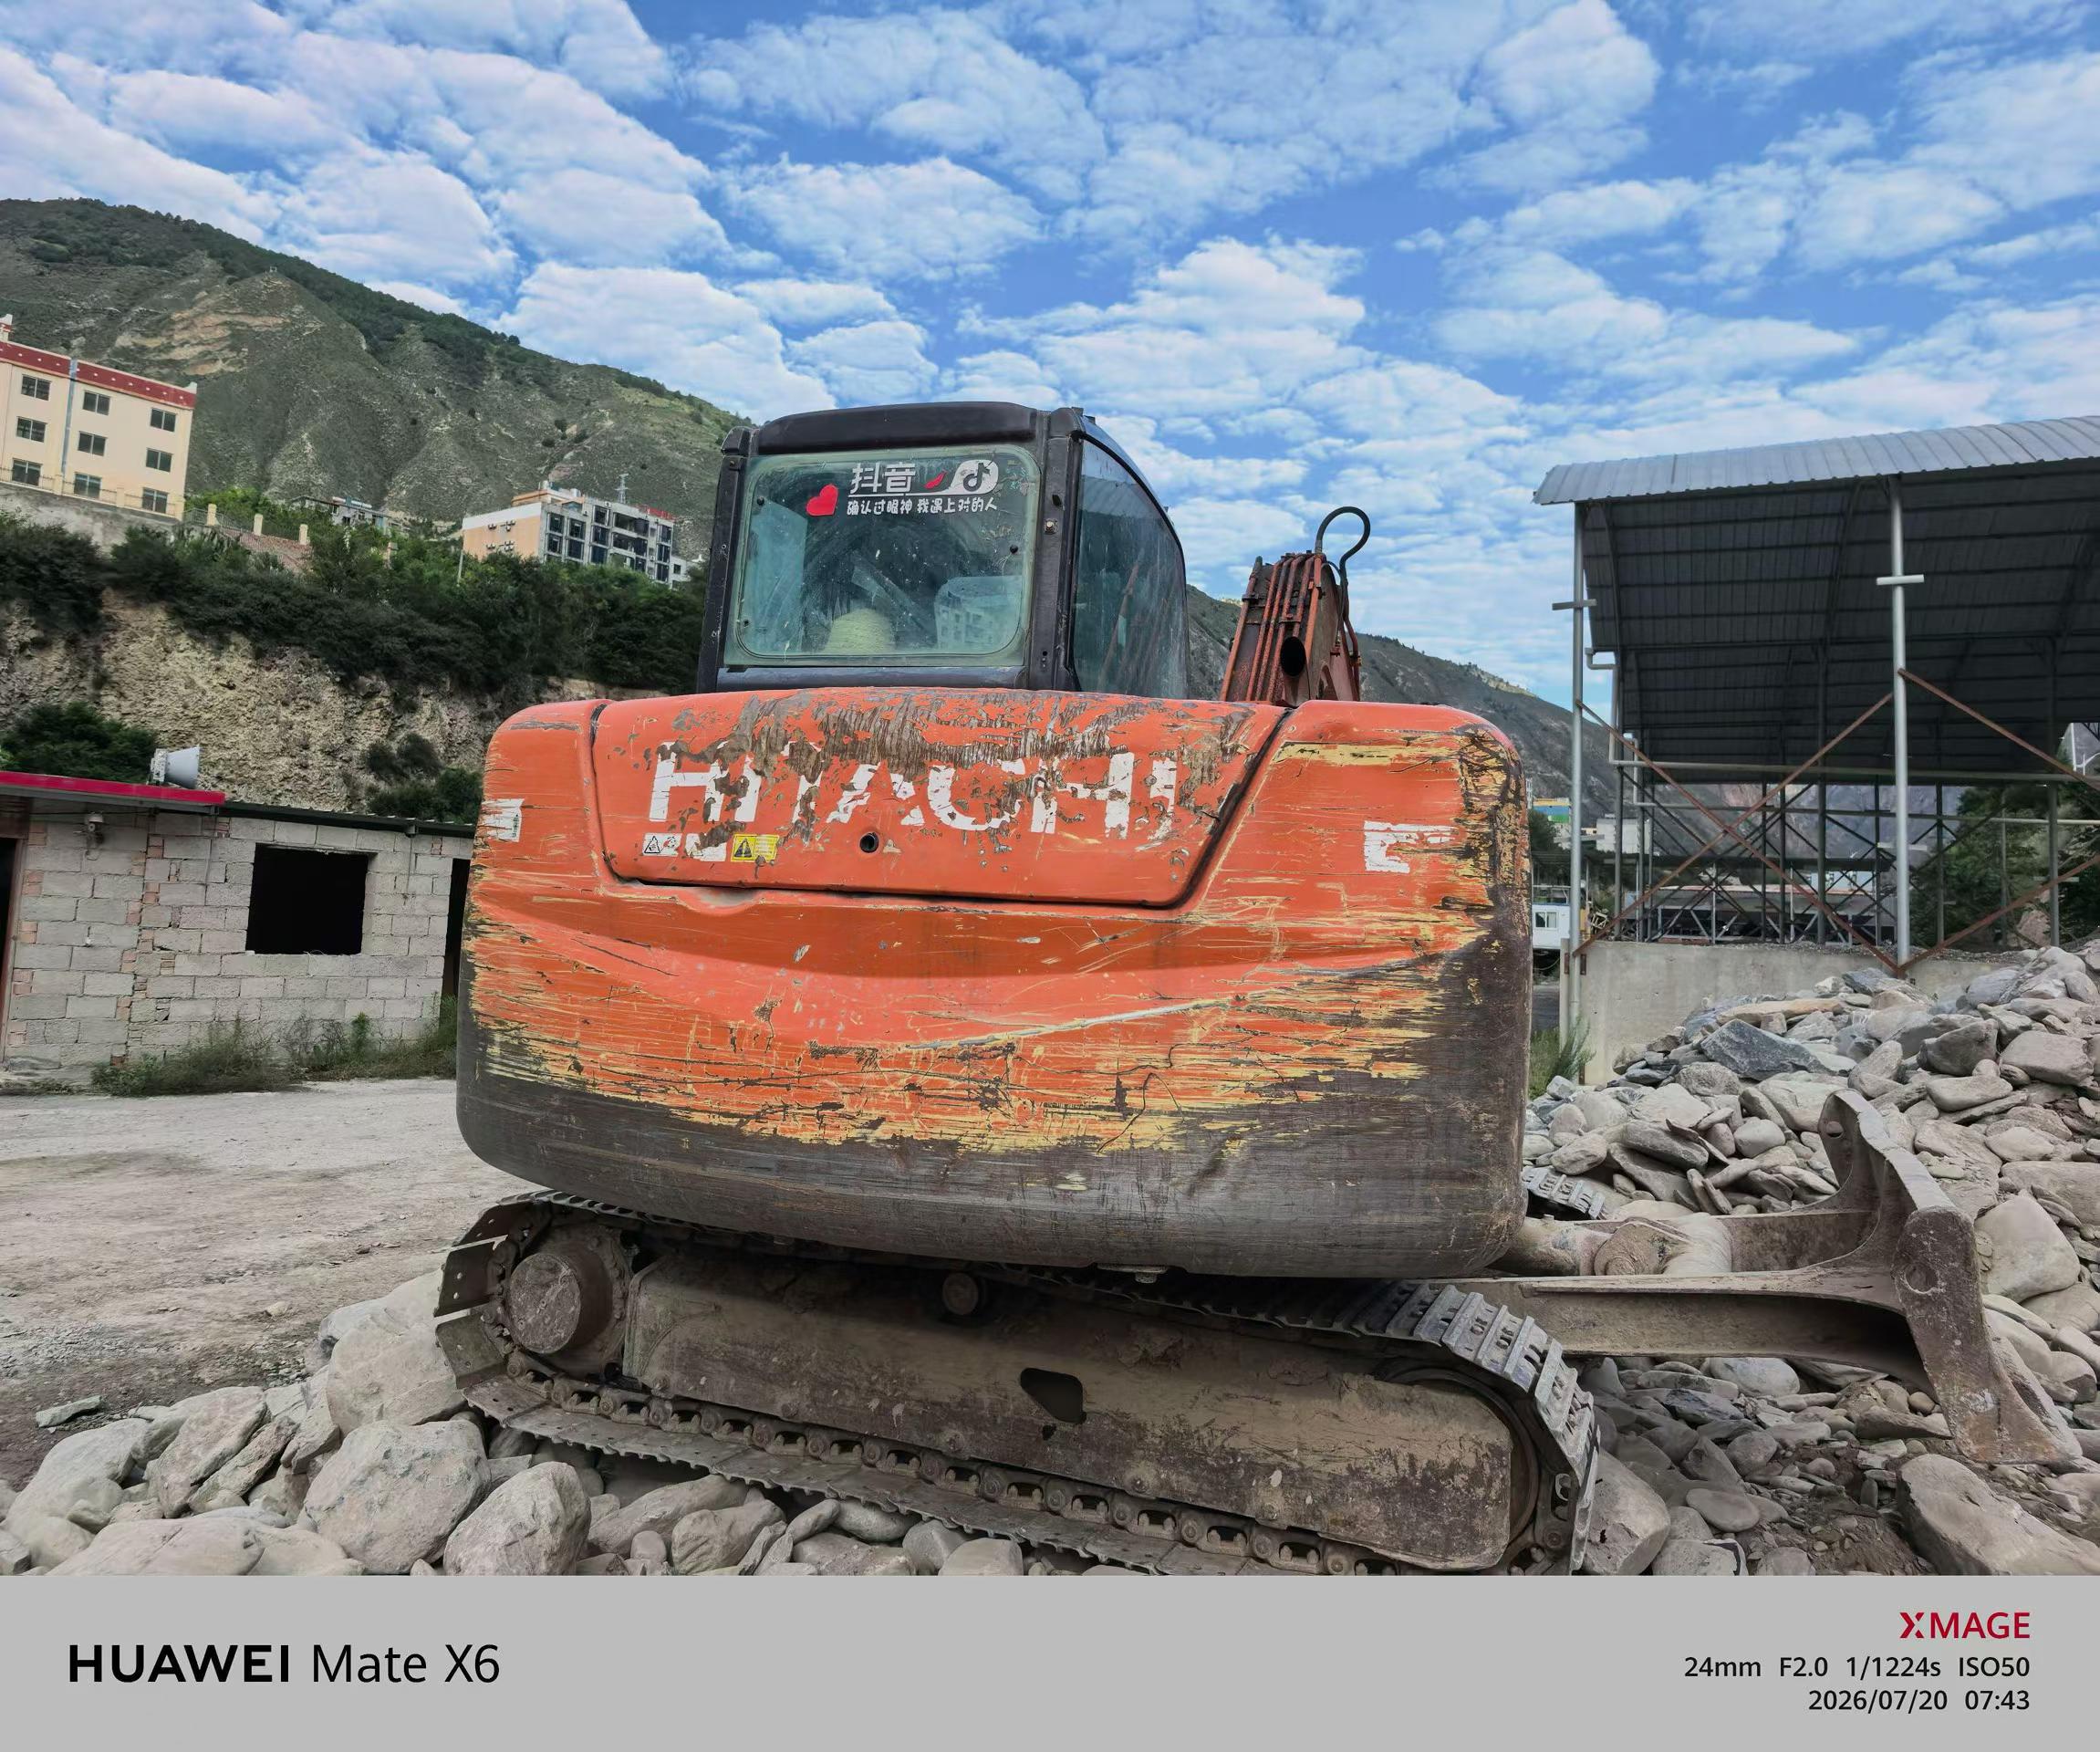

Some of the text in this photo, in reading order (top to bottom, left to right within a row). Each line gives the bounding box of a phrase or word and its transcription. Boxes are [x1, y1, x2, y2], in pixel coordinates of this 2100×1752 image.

[849, 462, 916, 495] 抖音
[847, 496, 998, 516] 确认过眼神 我遇上对的人
